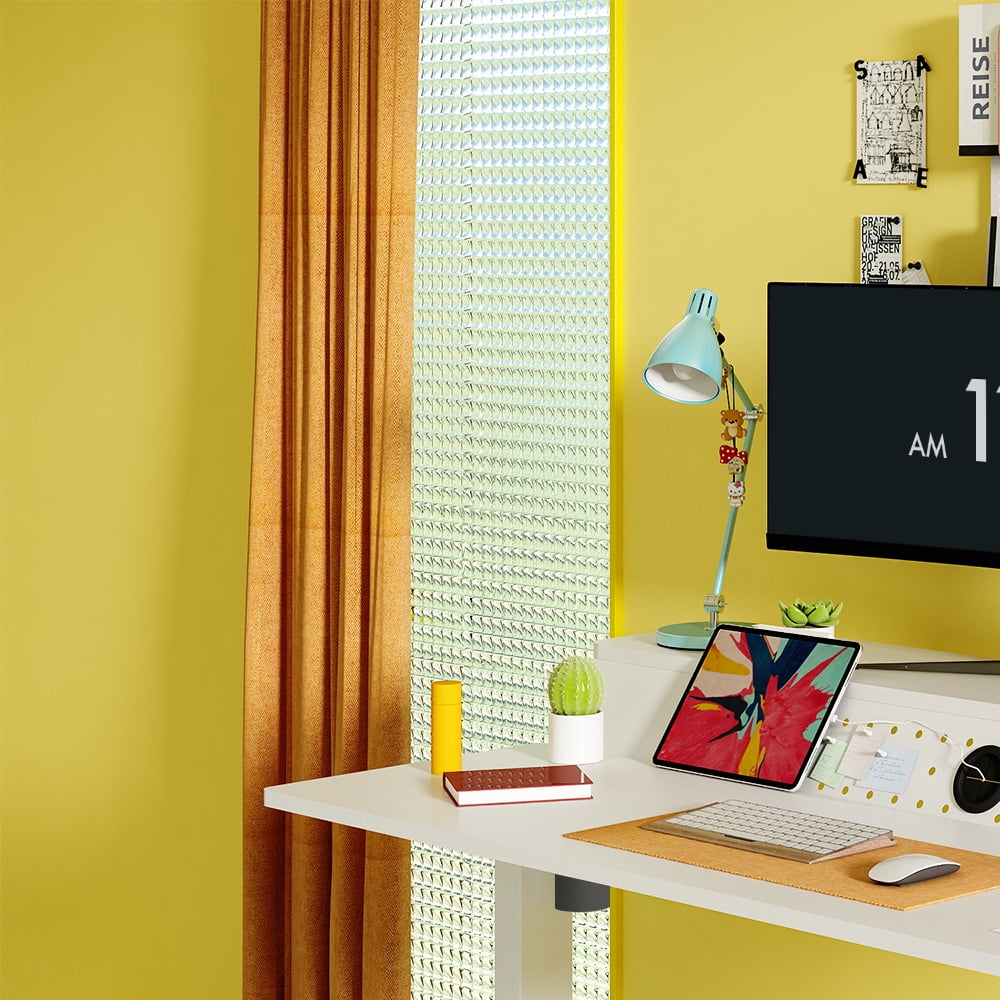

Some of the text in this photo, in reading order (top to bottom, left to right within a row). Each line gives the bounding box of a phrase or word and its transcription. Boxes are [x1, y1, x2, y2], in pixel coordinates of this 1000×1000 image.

[854, 60, 868, 80] S
[917, 55, 932, 77] A
[972, 36, 989, 119] REISE
[853, 159, 867, 179] A
[916, 168, 928, 188] E
[862, 252, 878, 262] HOF
[908, 432, 948, 458] AM
